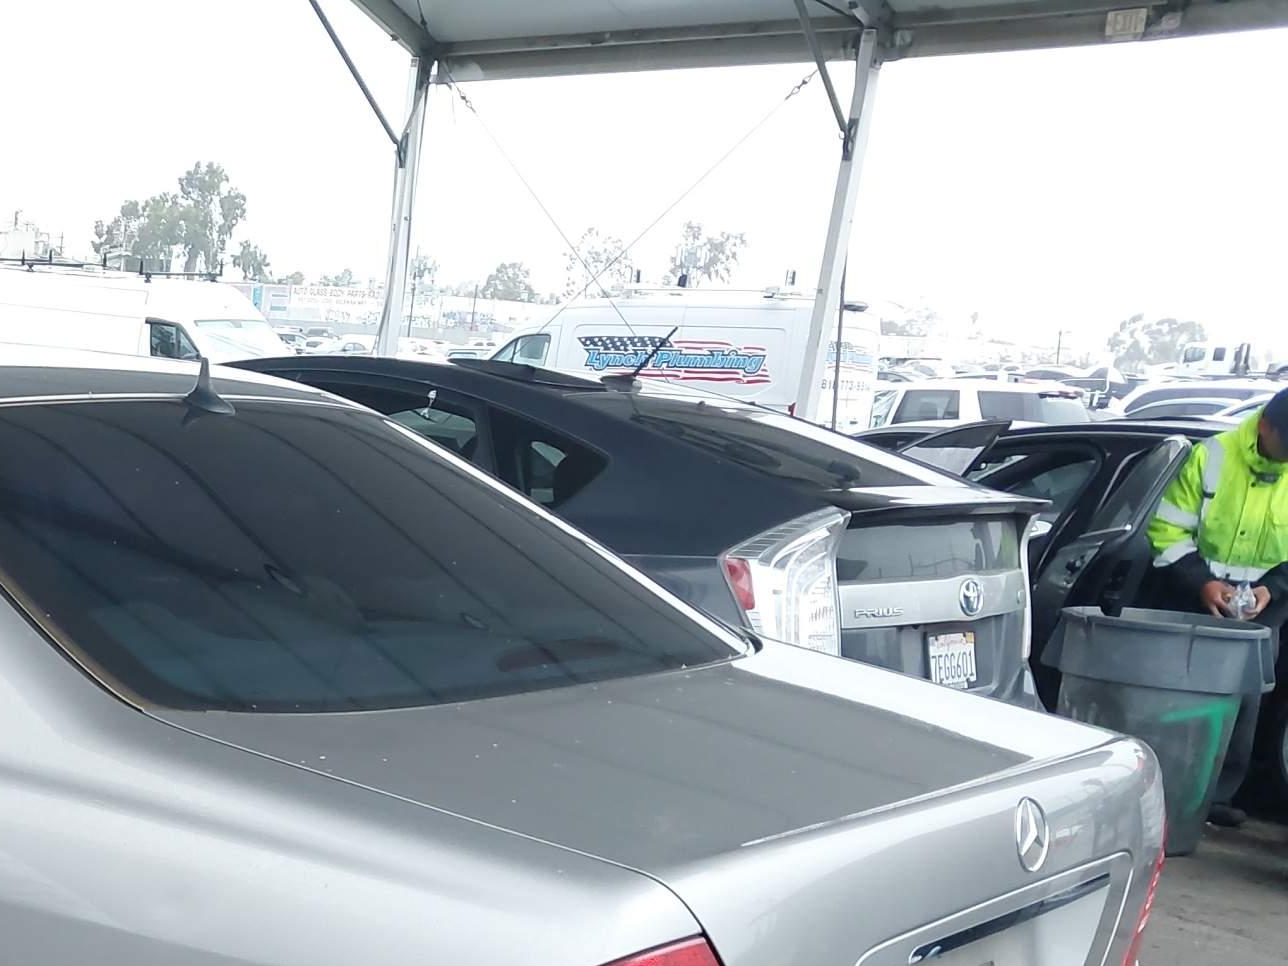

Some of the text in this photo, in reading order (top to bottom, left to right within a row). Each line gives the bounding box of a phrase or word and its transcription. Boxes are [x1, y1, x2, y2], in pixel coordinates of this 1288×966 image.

[585, 348, 767, 373] Lynch Plumbing
[855, 607, 905, 618] PRIUS
[931, 650, 975, 683] 7EGG601
